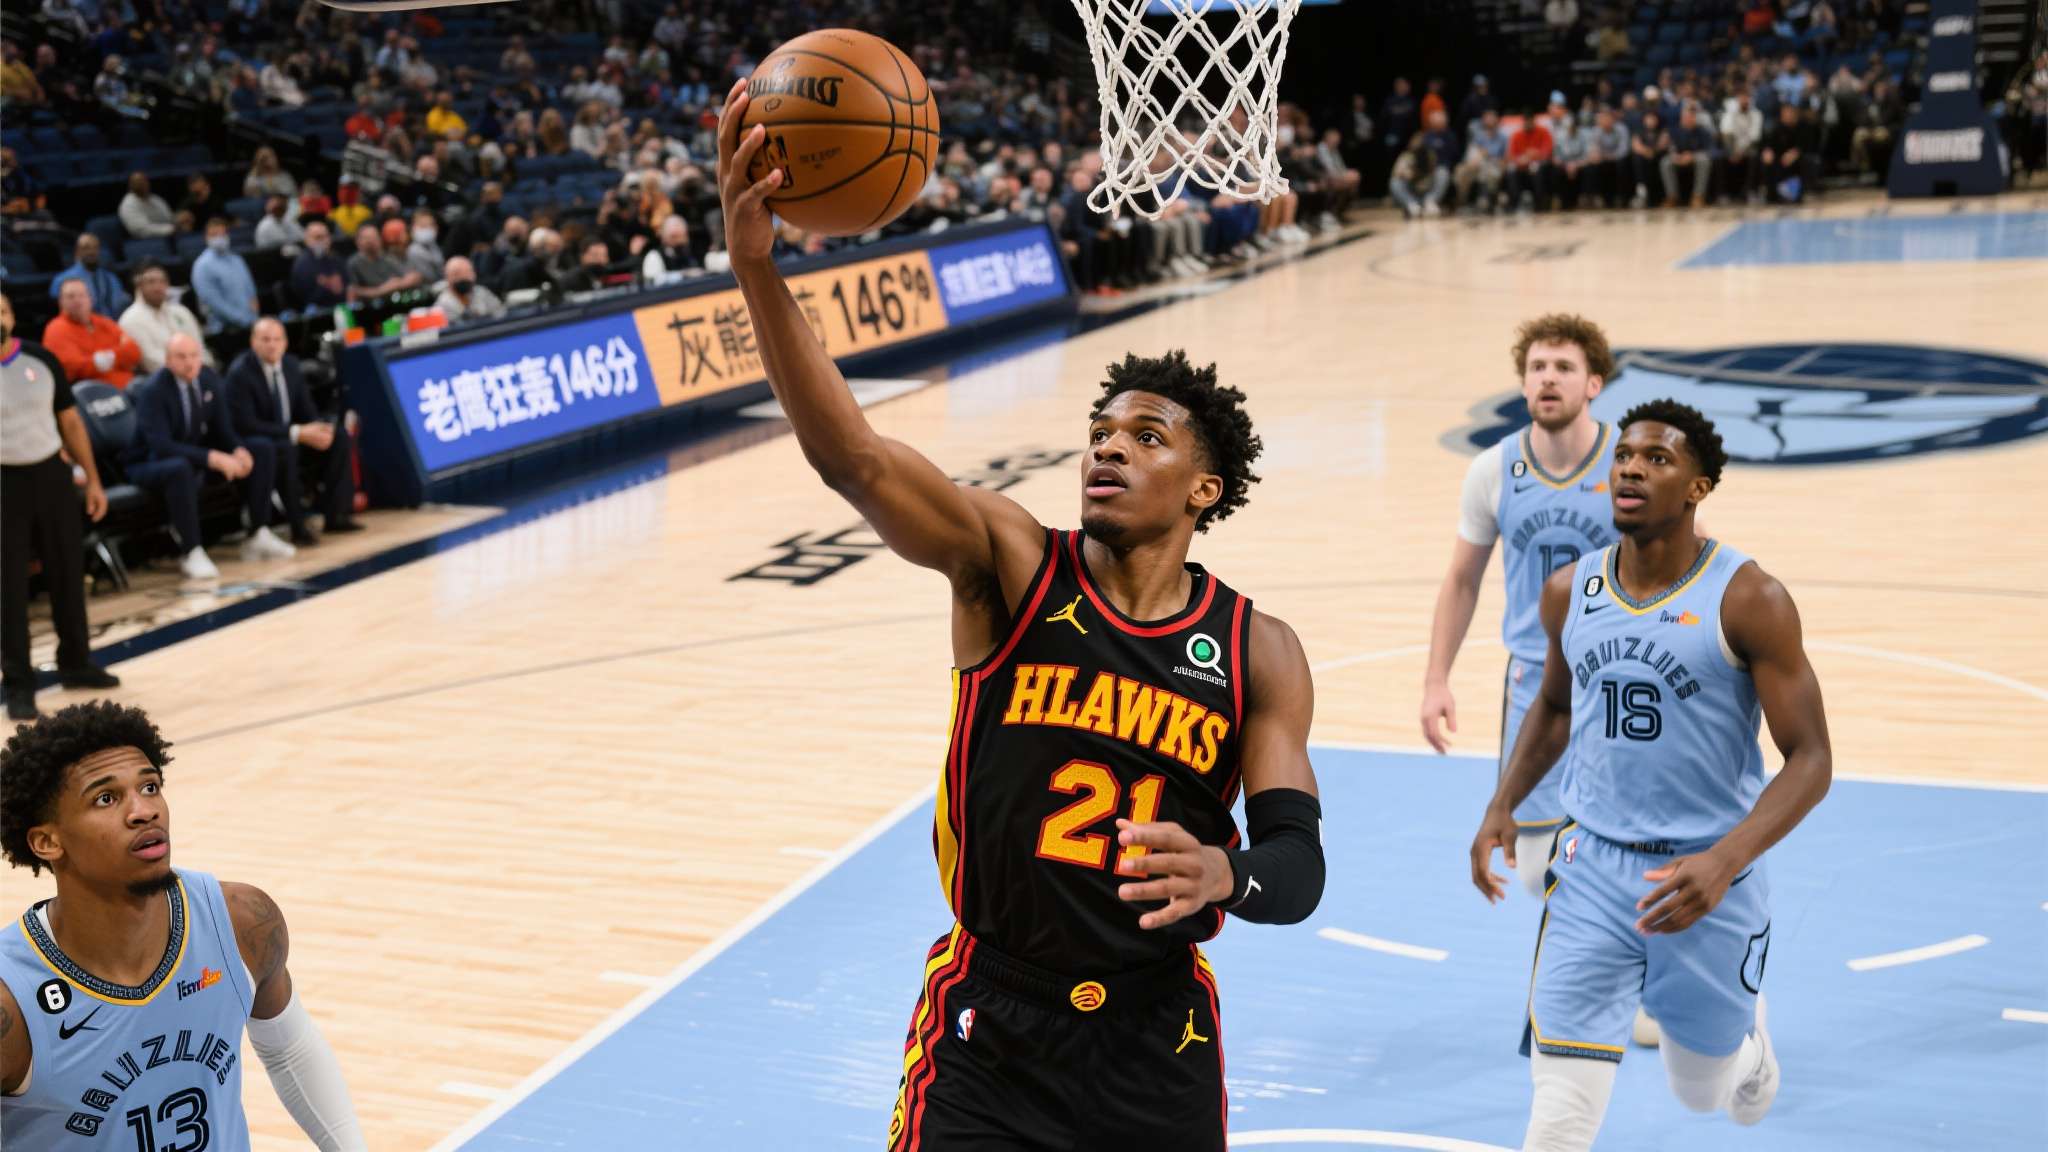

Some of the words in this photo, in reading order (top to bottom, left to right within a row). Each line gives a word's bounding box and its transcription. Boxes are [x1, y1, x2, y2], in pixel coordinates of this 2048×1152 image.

[1002, 664, 1231, 775] HLAWKS
[1034, 758, 1167, 879] 21
[44, 983, 66, 1011] 6
[126, 1086, 211, 1152] 13
